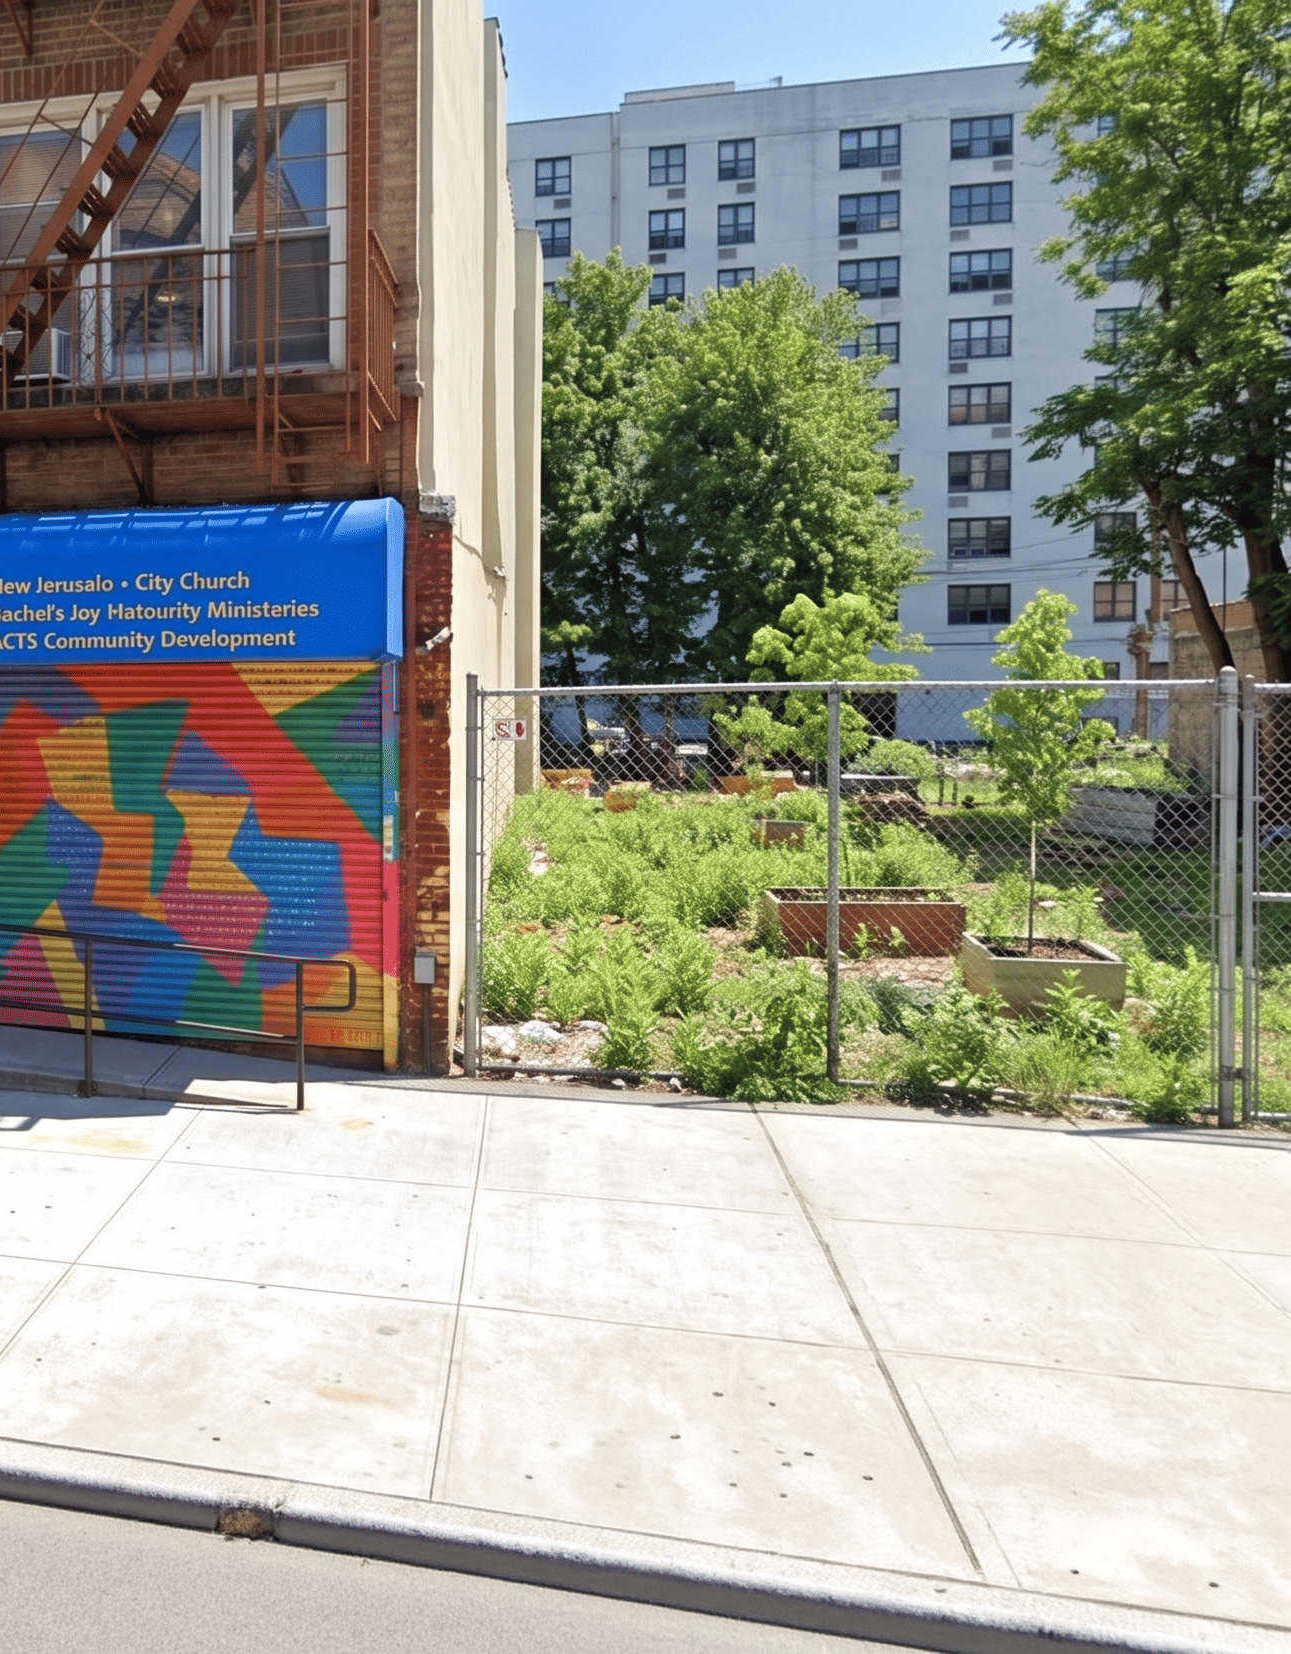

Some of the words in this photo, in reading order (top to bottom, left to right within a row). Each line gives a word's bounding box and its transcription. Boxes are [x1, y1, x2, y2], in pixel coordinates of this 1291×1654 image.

[35, 573, 114, 595] Jerusalo
[135, 573, 174, 596] City
[179, 570, 250, 591] Church
[69, 603, 101, 626] Joy
[44, 630, 155, 654] Community
[161, 628, 296, 652] Development
